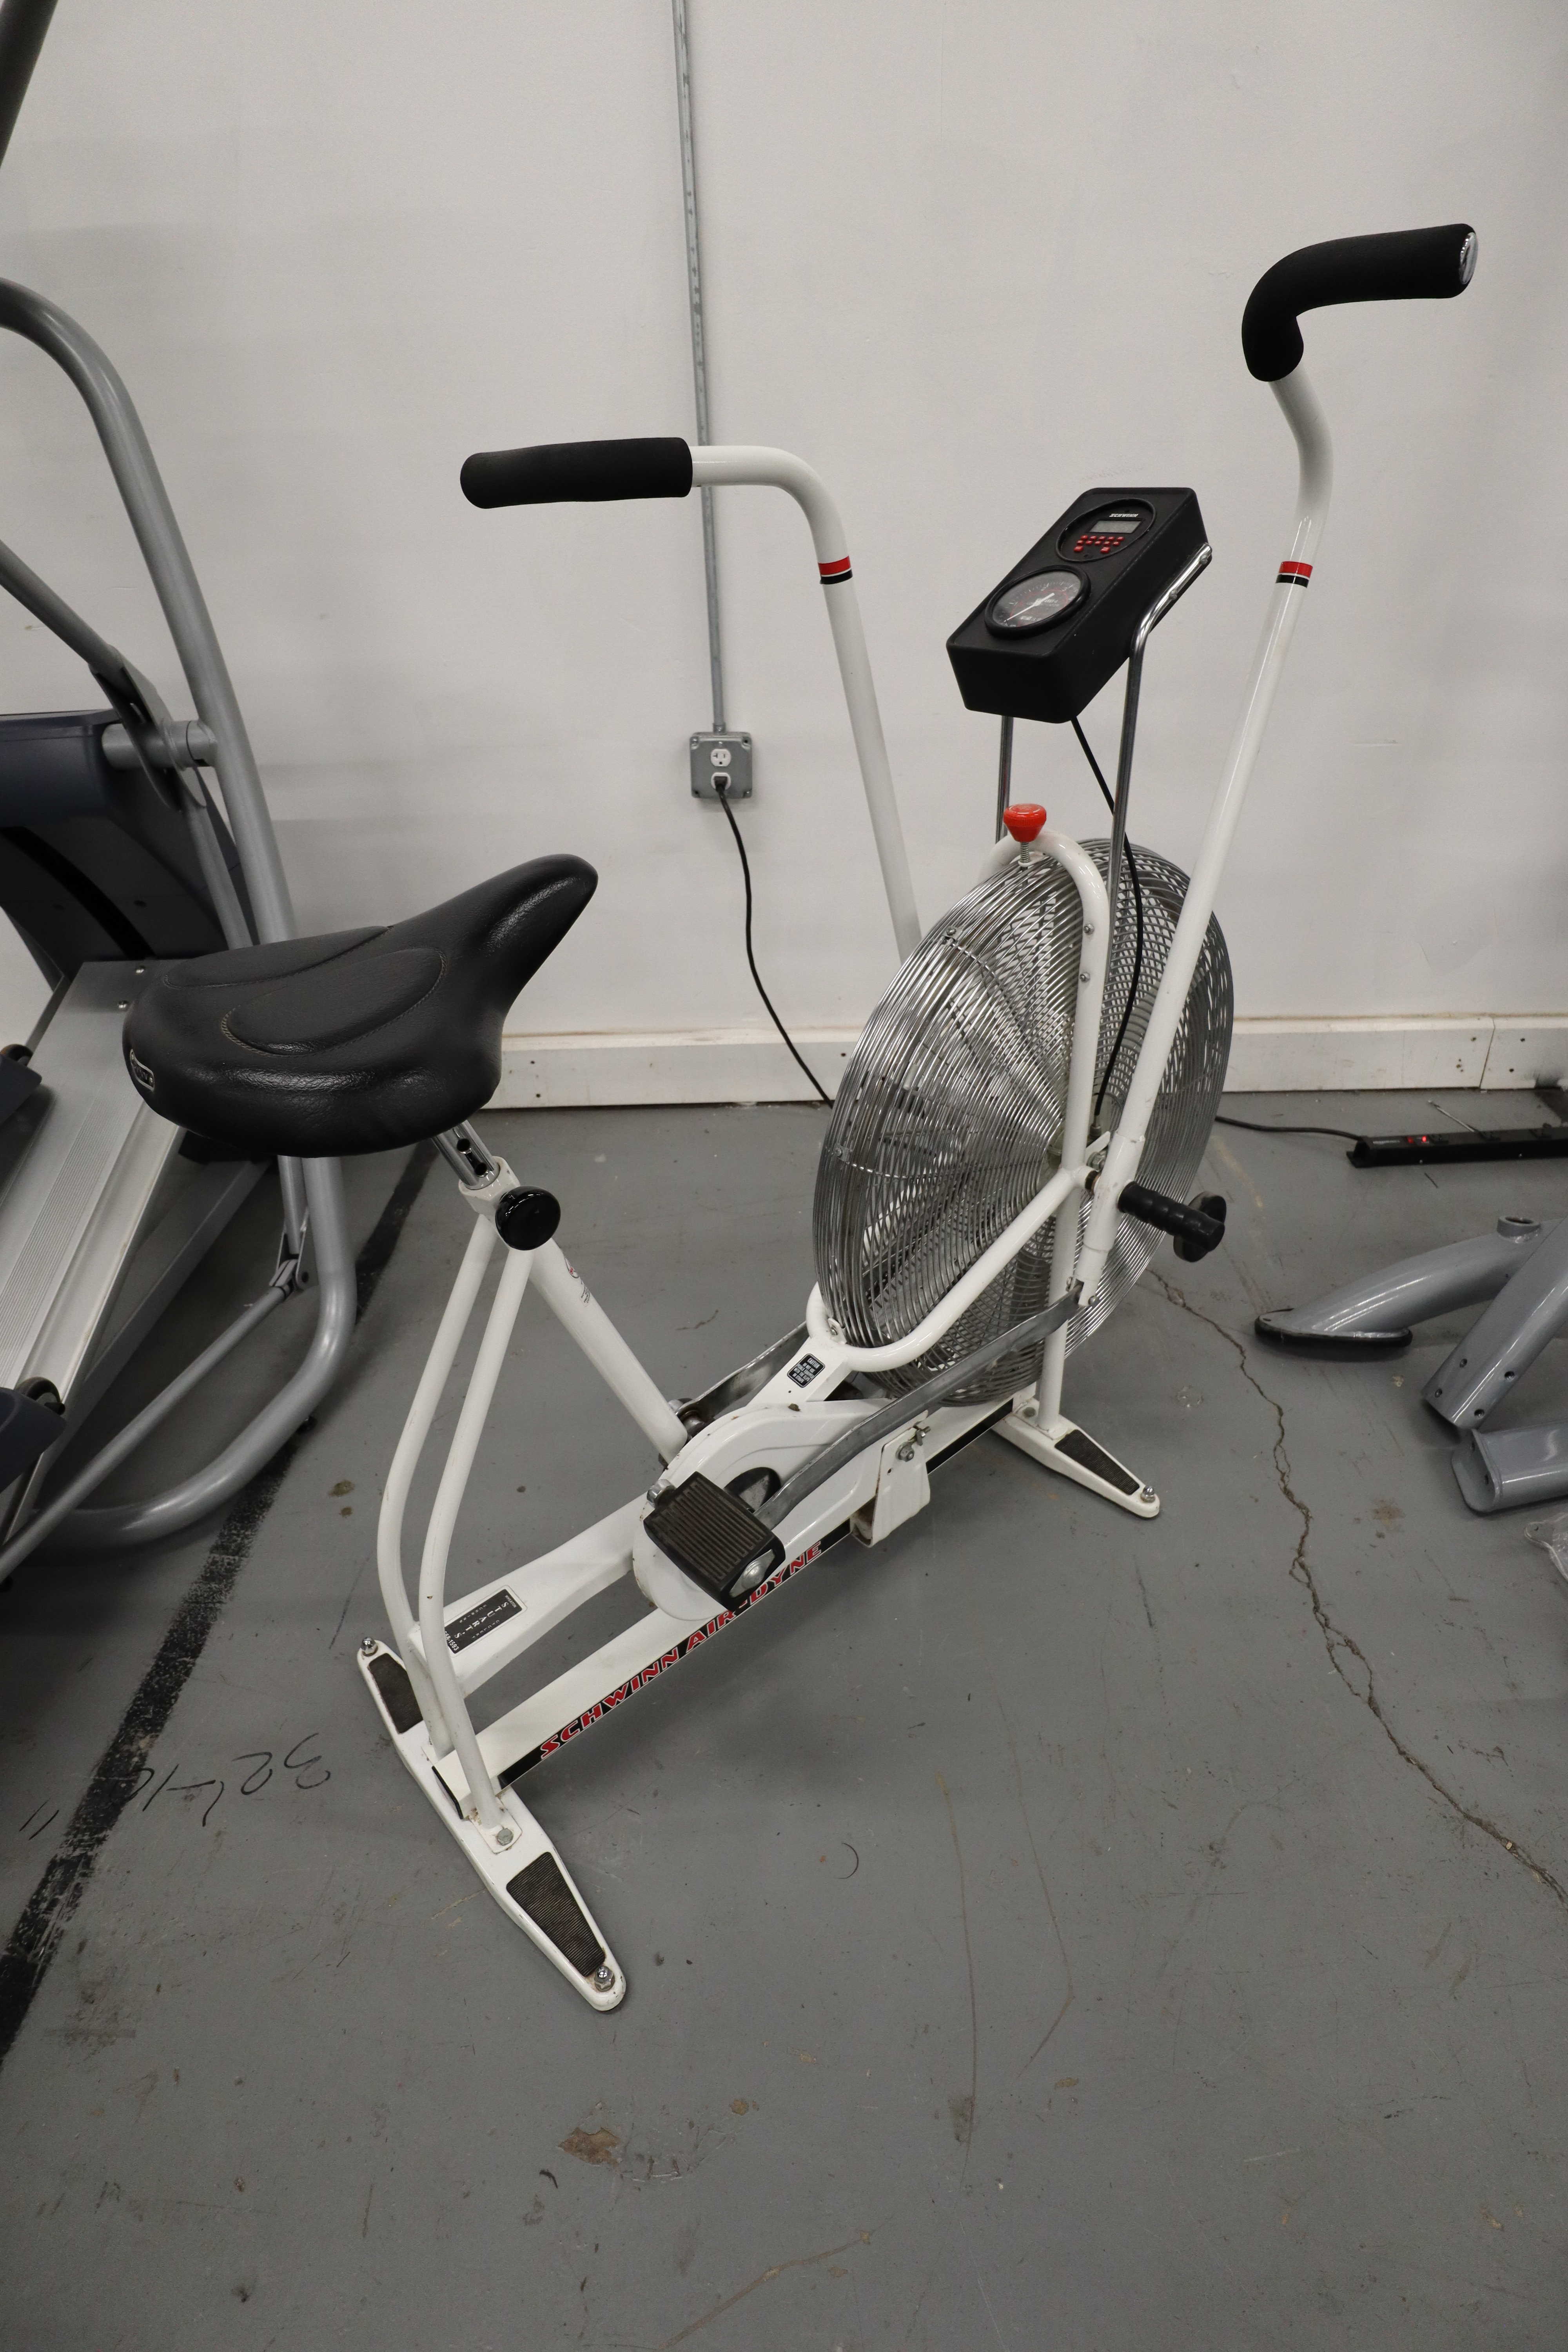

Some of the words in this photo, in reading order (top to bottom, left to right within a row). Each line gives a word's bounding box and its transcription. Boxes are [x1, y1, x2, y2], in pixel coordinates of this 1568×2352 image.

[454, 1602, 509, 1639] STUART'S
[445, 1631, 459, 1651] 68-1593
[540, 1646, 679, 1760] SCHWINN
[686, 1540, 822, 1655] AIR-DYNE
